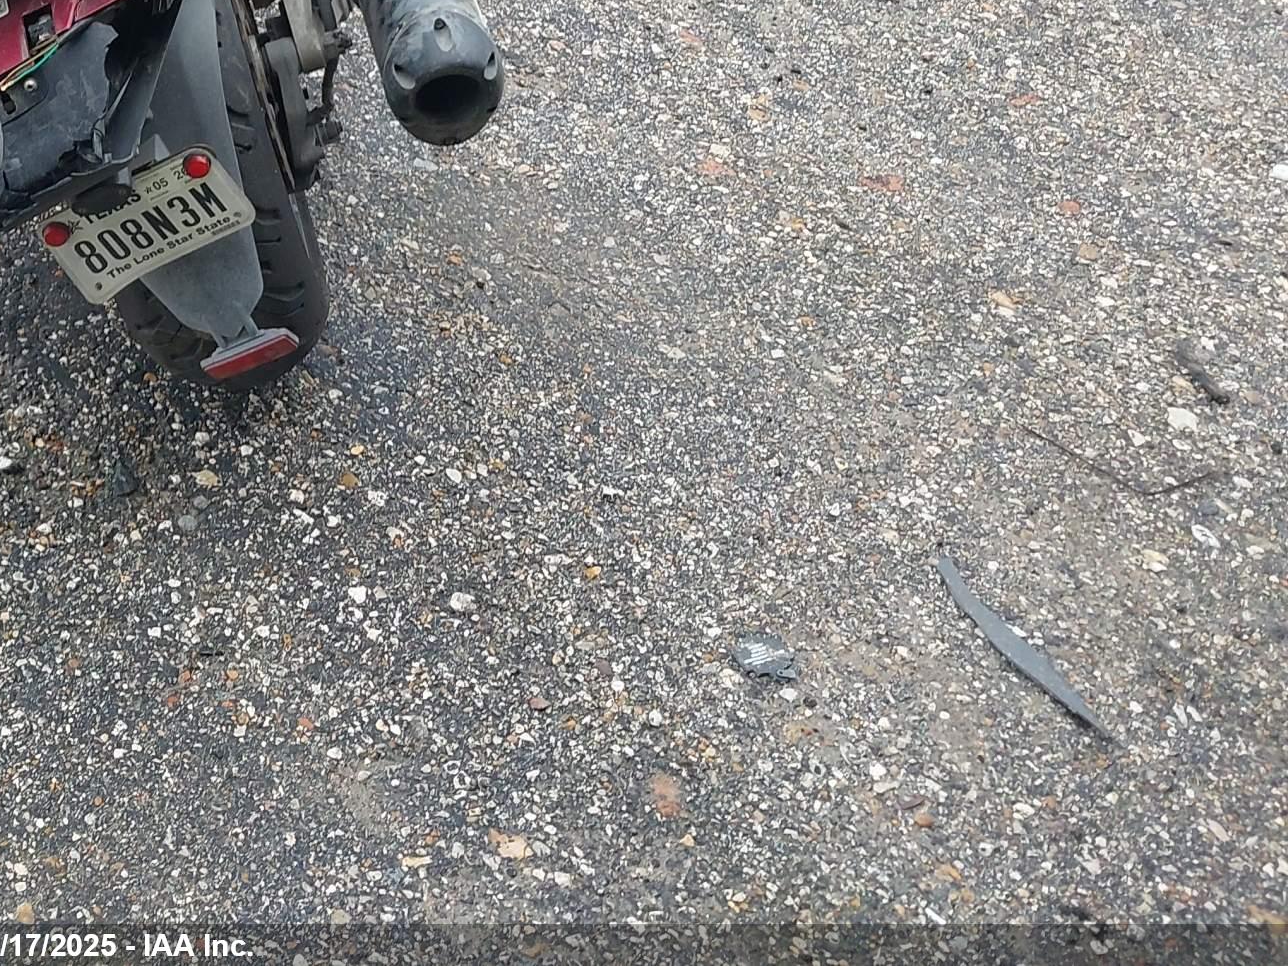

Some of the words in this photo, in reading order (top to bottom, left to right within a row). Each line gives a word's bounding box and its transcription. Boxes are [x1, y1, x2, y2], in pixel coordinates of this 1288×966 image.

[152, 177, 169, 191] 05
[74, 181, 227, 274] 808N3M
[107, 262, 132, 279] The
[133, 247, 165, 265] Lone
[166, 232, 193, 249] Star
[196, 216, 231, 235] State
